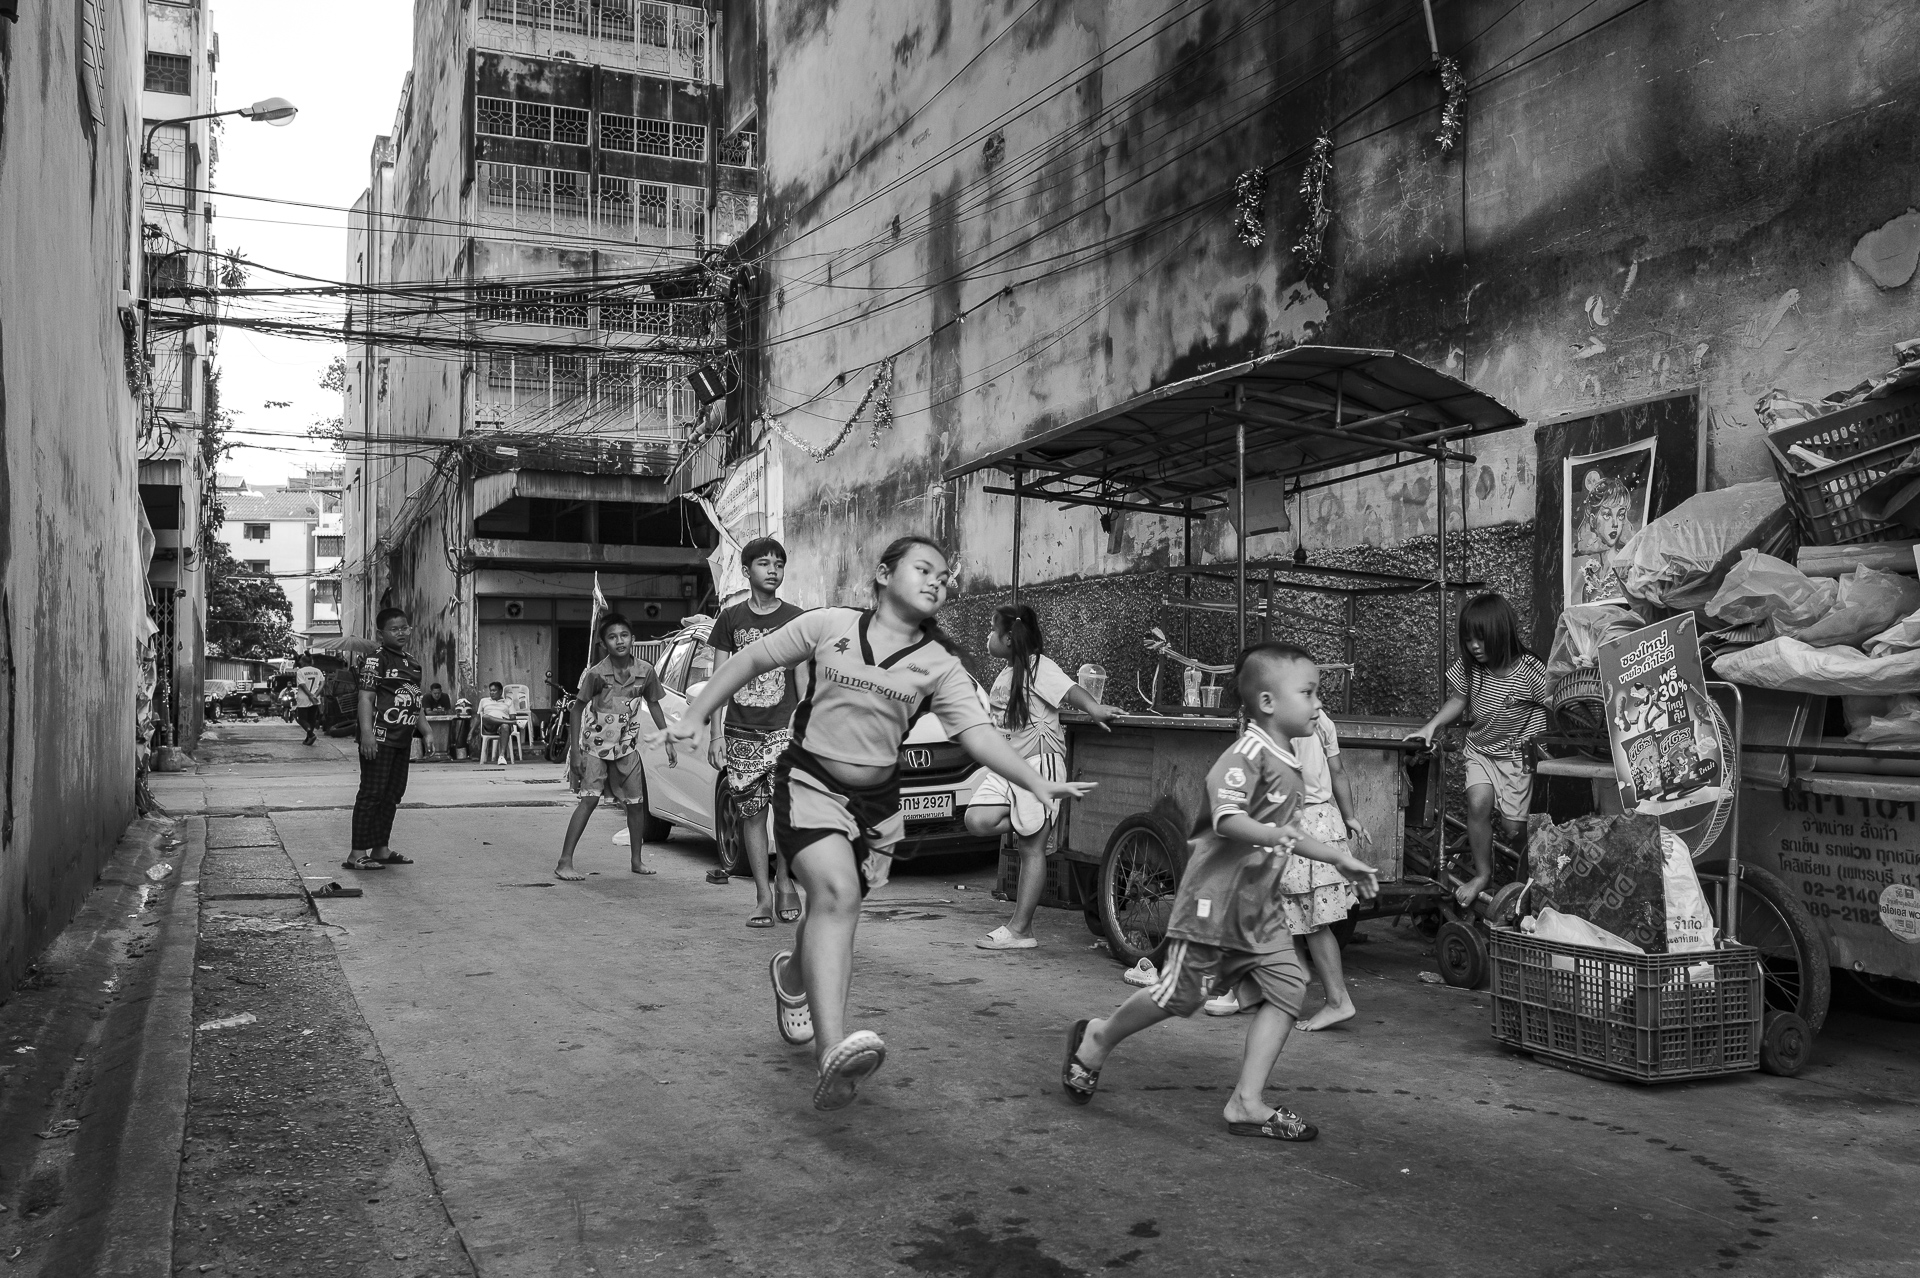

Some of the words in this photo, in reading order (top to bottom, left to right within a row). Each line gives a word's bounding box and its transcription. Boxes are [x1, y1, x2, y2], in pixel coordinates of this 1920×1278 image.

[1621, 629, 1667, 667] ซองใหญ่
[1659, 665, 1677, 684] ฟรี
[308, 676, 315, 692] 7
[824, 666, 918, 705] Winnersquad
[1659, 679, 1687, 701] 30%
[1667, 697, 1684, 712] ใหญ่
[383, 707, 416, 725] Cha
[1674, 709, 1686, 723] คุ้ม
[923, 795, 951, 810] 2927
[1802, 817, 1854, 836] จำหน่าย
[1781, 837, 1819, 855] รถเข็น
[1803, 881, 1880, 905] 02-2140
[1673, 916, 1702, 930] จำกัด
